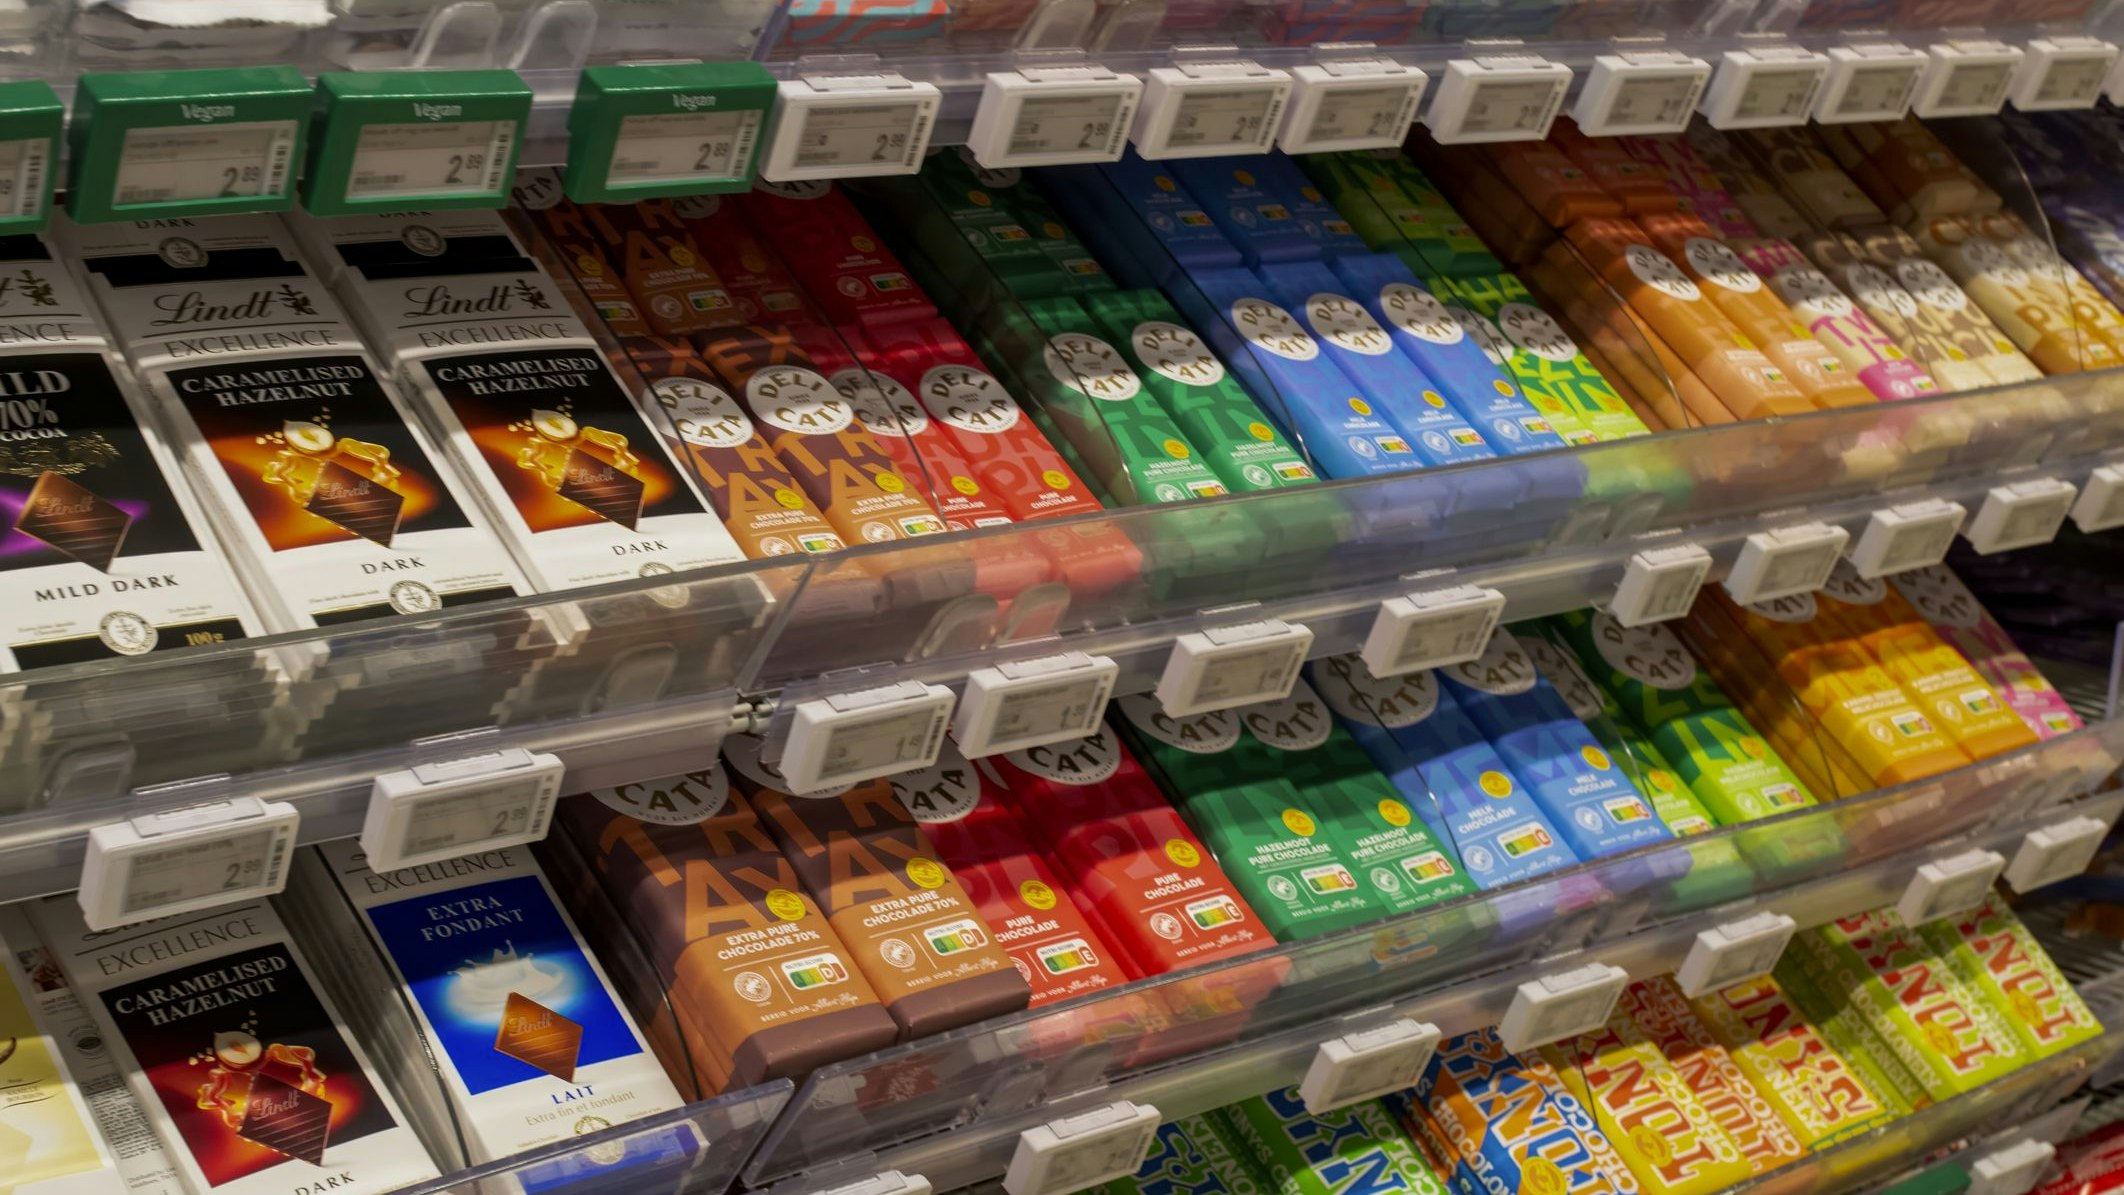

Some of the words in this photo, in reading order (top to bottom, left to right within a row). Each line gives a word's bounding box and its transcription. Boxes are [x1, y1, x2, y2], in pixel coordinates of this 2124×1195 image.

[180, 104, 236, 123] Vegan
[413, 103, 463, 121] Vegan
[672, 94, 717, 111] Vegan
[151, 292, 272, 327] Lindt
[404, 284, 514, 319] Lindt
[164, 328, 338, 359] EXCELLENCE
[418, 323, 570, 348] EXCELLENCE
[181, 365, 365, 394] CARAMELISED
[437, 357, 599, 384] CARAMELISED
[1157, 354, 1215, 380] CATA
[216, 382, 354, 408] HAZELNUT
[469, 373, 590, 396] HAZELNUT
[758, 373, 824, 399] DELI
[931, 371, 990, 398] DELI
[775, 400, 842, 428] CATA
[947, 399, 1009, 426] CATA
[675, 414, 742, 440] CATA
[611, 539, 669, 556] DARK
[361, 556, 426, 575] DARK
[35, 584, 100, 602] MILD
[112, 574, 179, 593] DARK
[1458, 651, 1526, 685] CATA
[1151, 709, 1227, 741] CATA
[1247, 702, 1319, 739] CATA
[1026, 733, 1108, 774] CATA
[614, 769, 713, 813] CATA
[1567, 778, 1618, 797] CHOCOLADE
[1575, 773, 1598, 785] MELK
[1458, 806, 1518, 834] CHOCOLADE
[1467, 804, 1496, 820] MELK
[1255, 837, 1312, 854] HAZELNOOT
[1350, 847, 1375, 860] PURE
[1374, 831, 1429, 852] CHOCOLADE
[1356, 826, 1409, 848] HAZELNOOT
[1248, 854, 1275, 866] PURE
[1273, 843, 1332, 862] CHOCOLADE
[365, 849, 517, 895] EXCELLENCE
[1154, 872, 1182, 886] PURE
[870, 899, 909, 914] EXTRA
[908, 890, 940, 905] PURE
[1144, 877, 1206, 900] CHOCOLADE
[426, 894, 503, 921] EXTRA
[863, 903, 936, 928] CHOCOLADE
[935, 897, 960, 910] 70%
[421, 907, 524, 942] FONDANT
[726, 930, 766, 946] EXTRA
[767, 922, 800, 937] PURE
[994, 919, 1061, 943] CHOCOLADE
[1005, 915, 1036, 929] PURE
[96, 917, 263, 977] EXCELLENCE
[717, 935, 795, 960] CHOCOLADE
[795, 930, 821, 943] 70%
[115, 955, 288, 1016] CARAMELISED
[147, 978, 277, 1027] HAZELNUT
[251, 1091, 301, 1122] Lindt
[551, 1084, 595, 1105] LAIT
[525, 1111, 559, 1127] Extra
[576, 1103, 590, 1113] et
[589, 1090, 636, 1111] fondant
[295, 1172, 356, 1195] DARK
